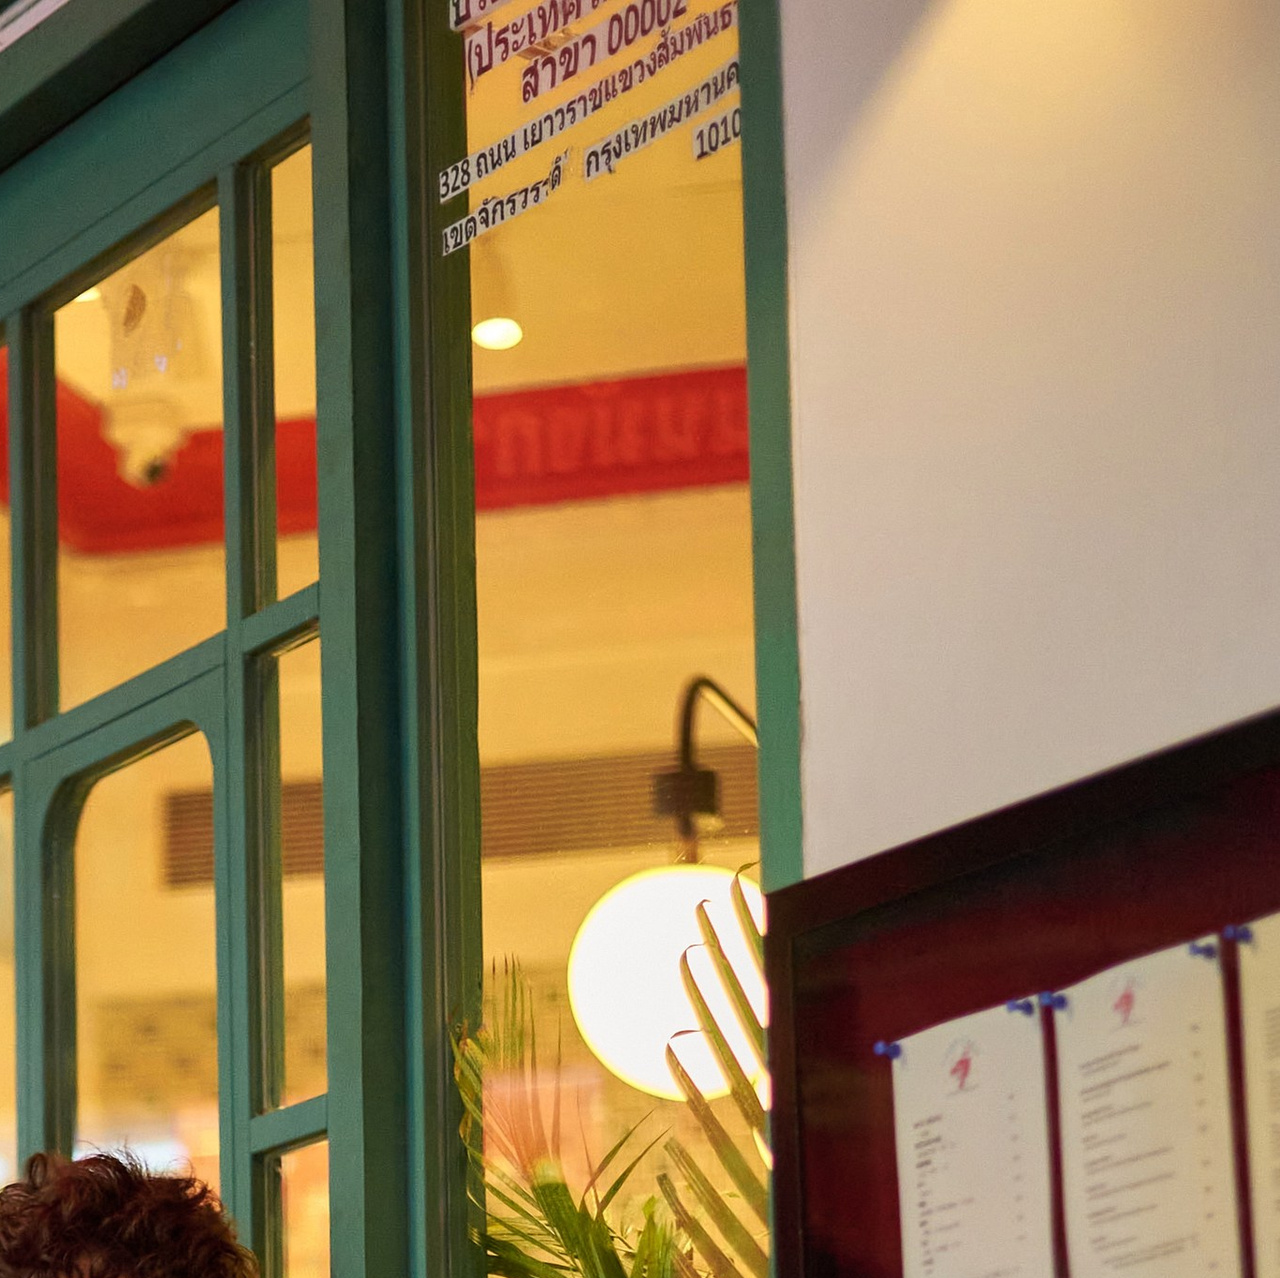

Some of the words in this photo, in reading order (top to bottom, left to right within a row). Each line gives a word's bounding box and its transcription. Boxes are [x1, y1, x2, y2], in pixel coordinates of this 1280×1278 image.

[522, 33, 597, 103] สาขา
[440, 158, 470, 199] 328
[476, 135, 517, 179] ถนน
